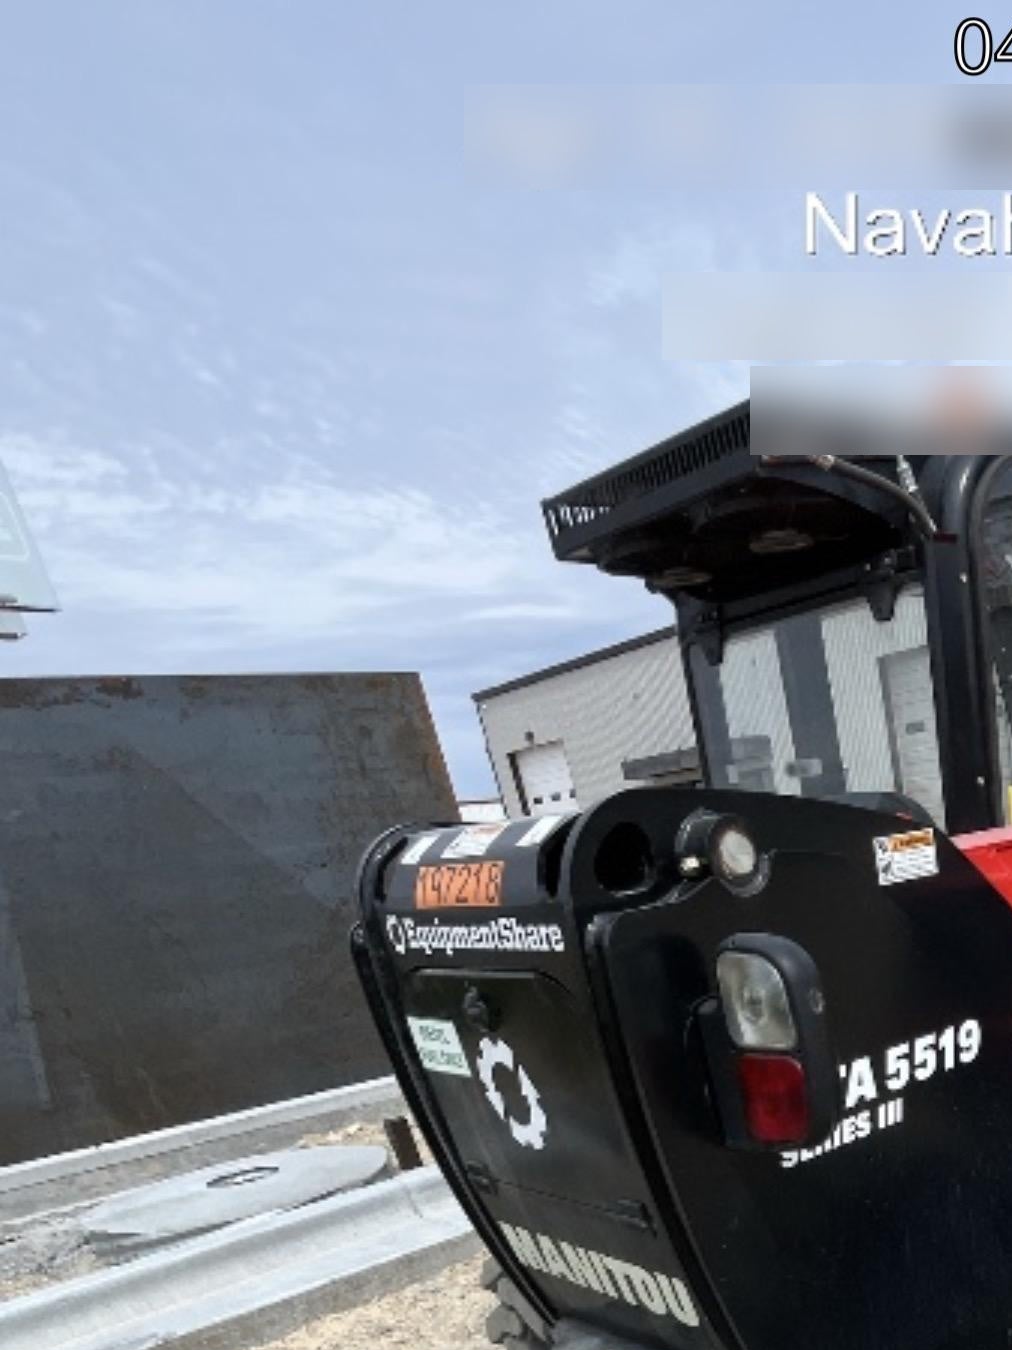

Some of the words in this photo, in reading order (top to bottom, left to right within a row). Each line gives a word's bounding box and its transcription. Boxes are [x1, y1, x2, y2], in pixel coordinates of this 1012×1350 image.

[404, 917, 565, 956] EquipmentShare
[838, 1055, 879, 1108] A
[884, 1018, 982, 1091] 5519
[878, 1097, 904, 1130] III
